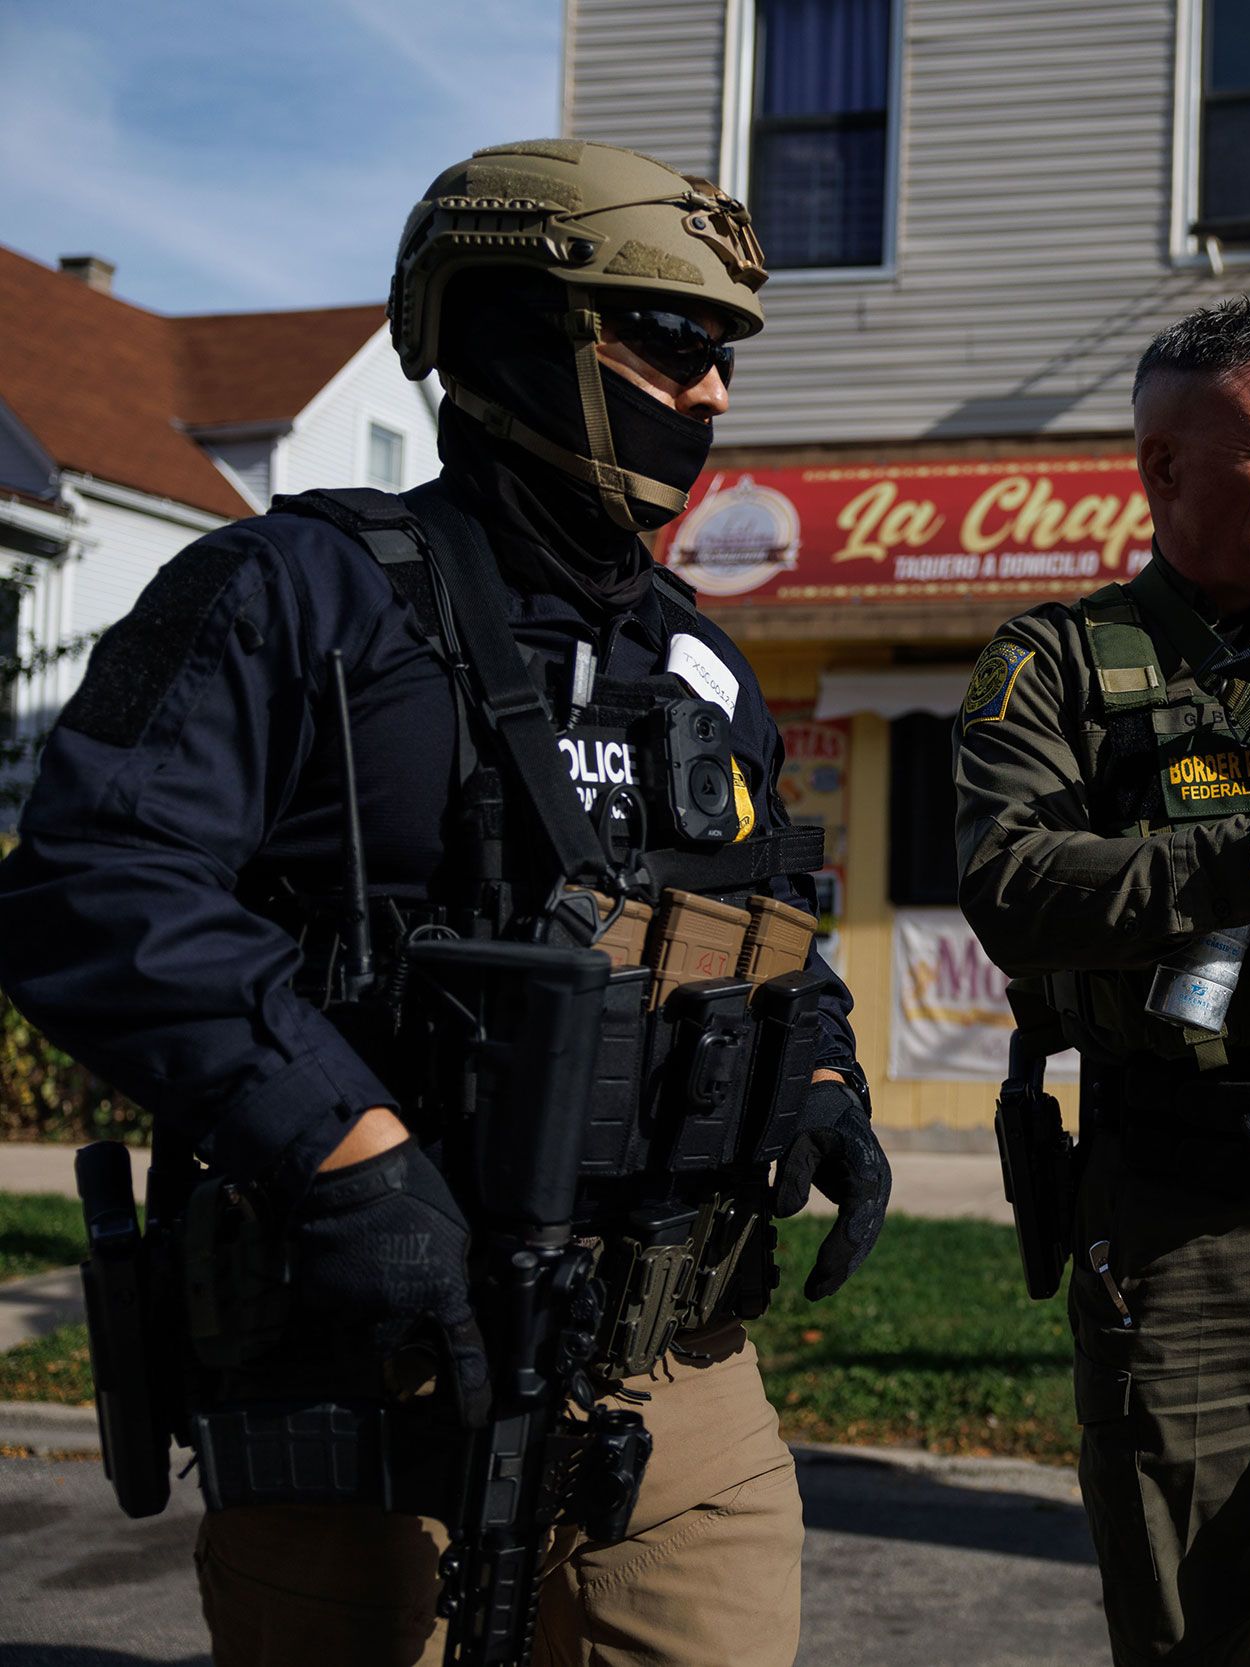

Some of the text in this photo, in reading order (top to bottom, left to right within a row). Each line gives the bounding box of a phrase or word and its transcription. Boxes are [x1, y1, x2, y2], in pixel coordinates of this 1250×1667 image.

[832, 481, 945, 563] La
[558, 738, 640, 785] OLICE
[1169, 751, 1243, 785] BORDER
